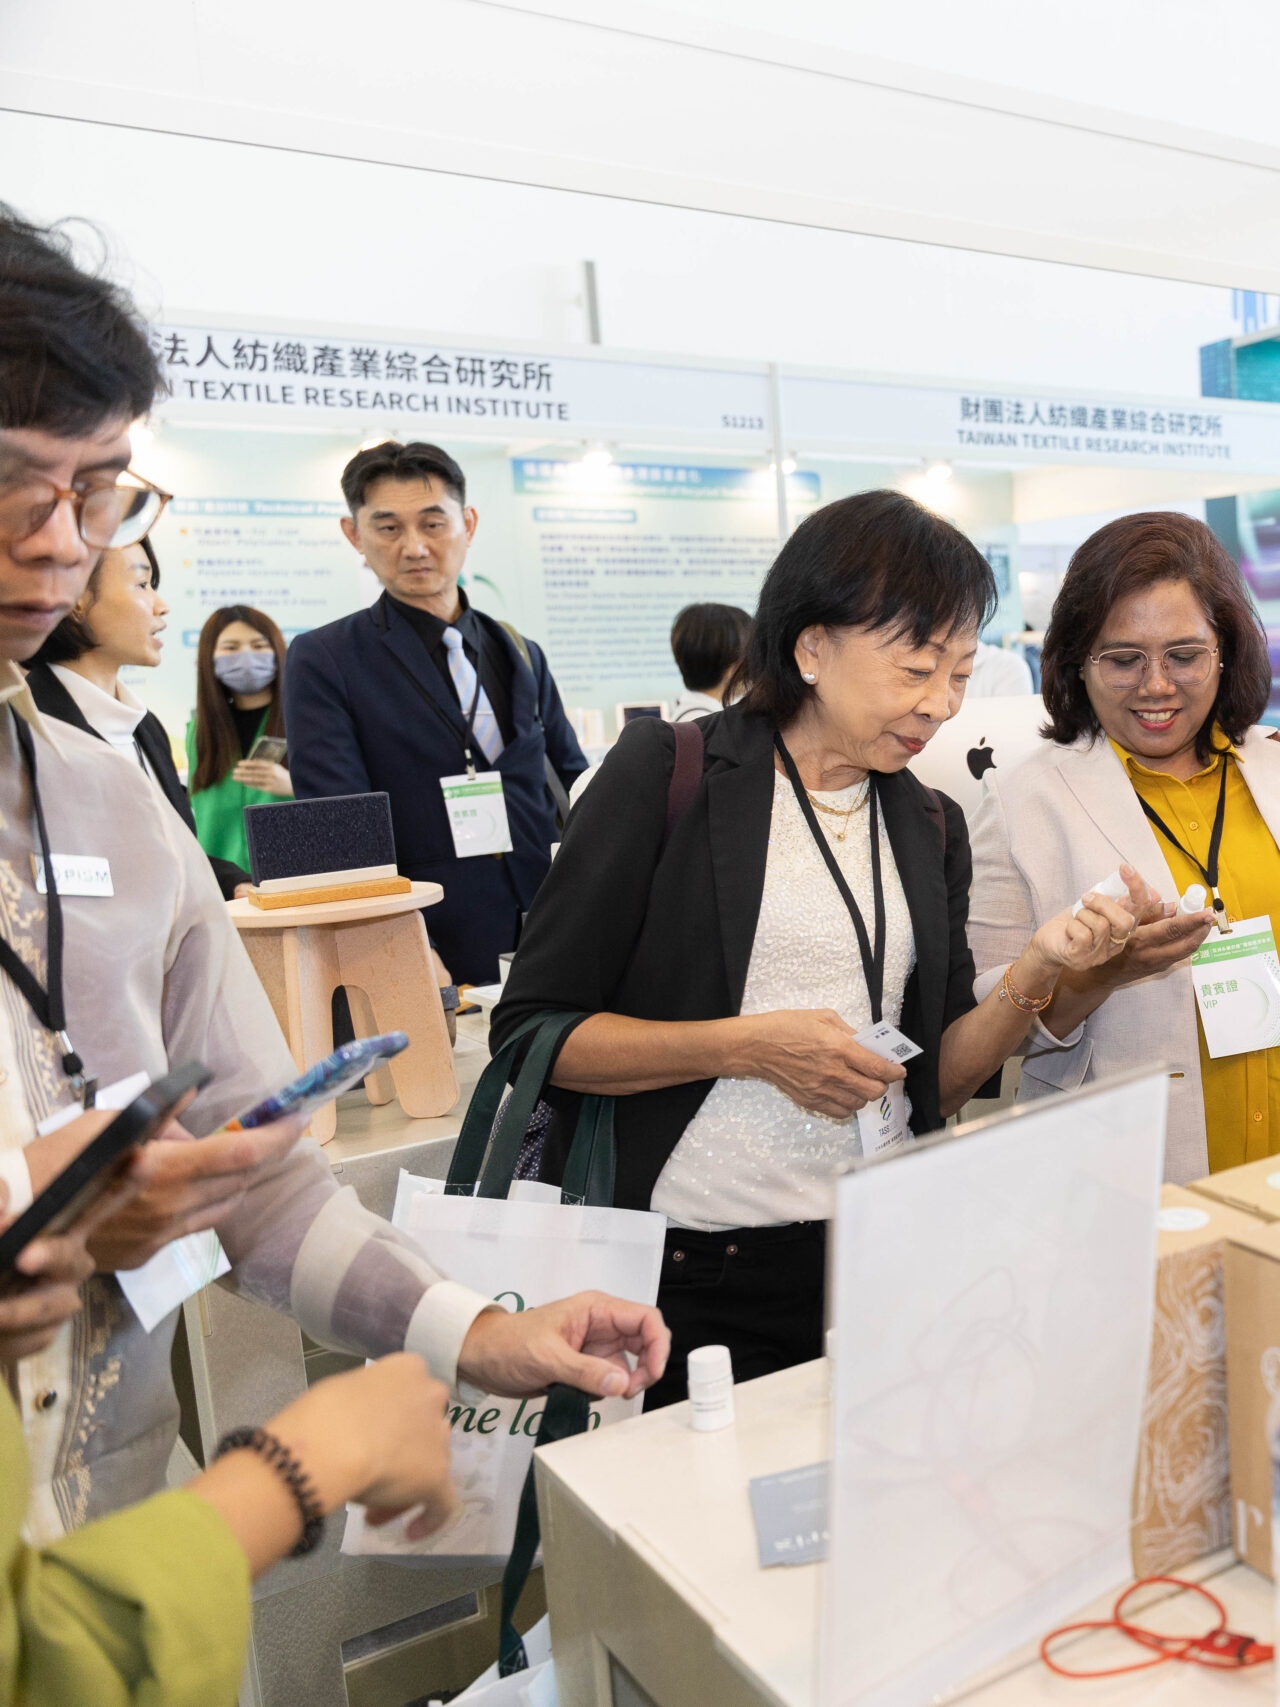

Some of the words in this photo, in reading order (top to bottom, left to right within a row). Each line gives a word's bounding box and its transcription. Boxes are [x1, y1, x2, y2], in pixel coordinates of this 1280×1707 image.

[152, 332, 553, 393] 法人紡織產業綜合研究所
[184, 379, 296, 405] TEXTILE
[304, 386, 439, 413] RESEARCH
[447, 396, 570, 420] INSTITUTE
[960, 396, 1223, 438] 財團法人紡織產業綜合研究所
[956, 429, 1018, 448] TAIWAN
[1023, 433, 1081, 452] TEXTILE
[1085, 437, 1160, 456] RESEARCH
[1163, 442, 1232, 460] INSTITUTE
[1200, 979, 1239, 997] 貴賓證
[1203, 1000, 1218, 1009] VIP
